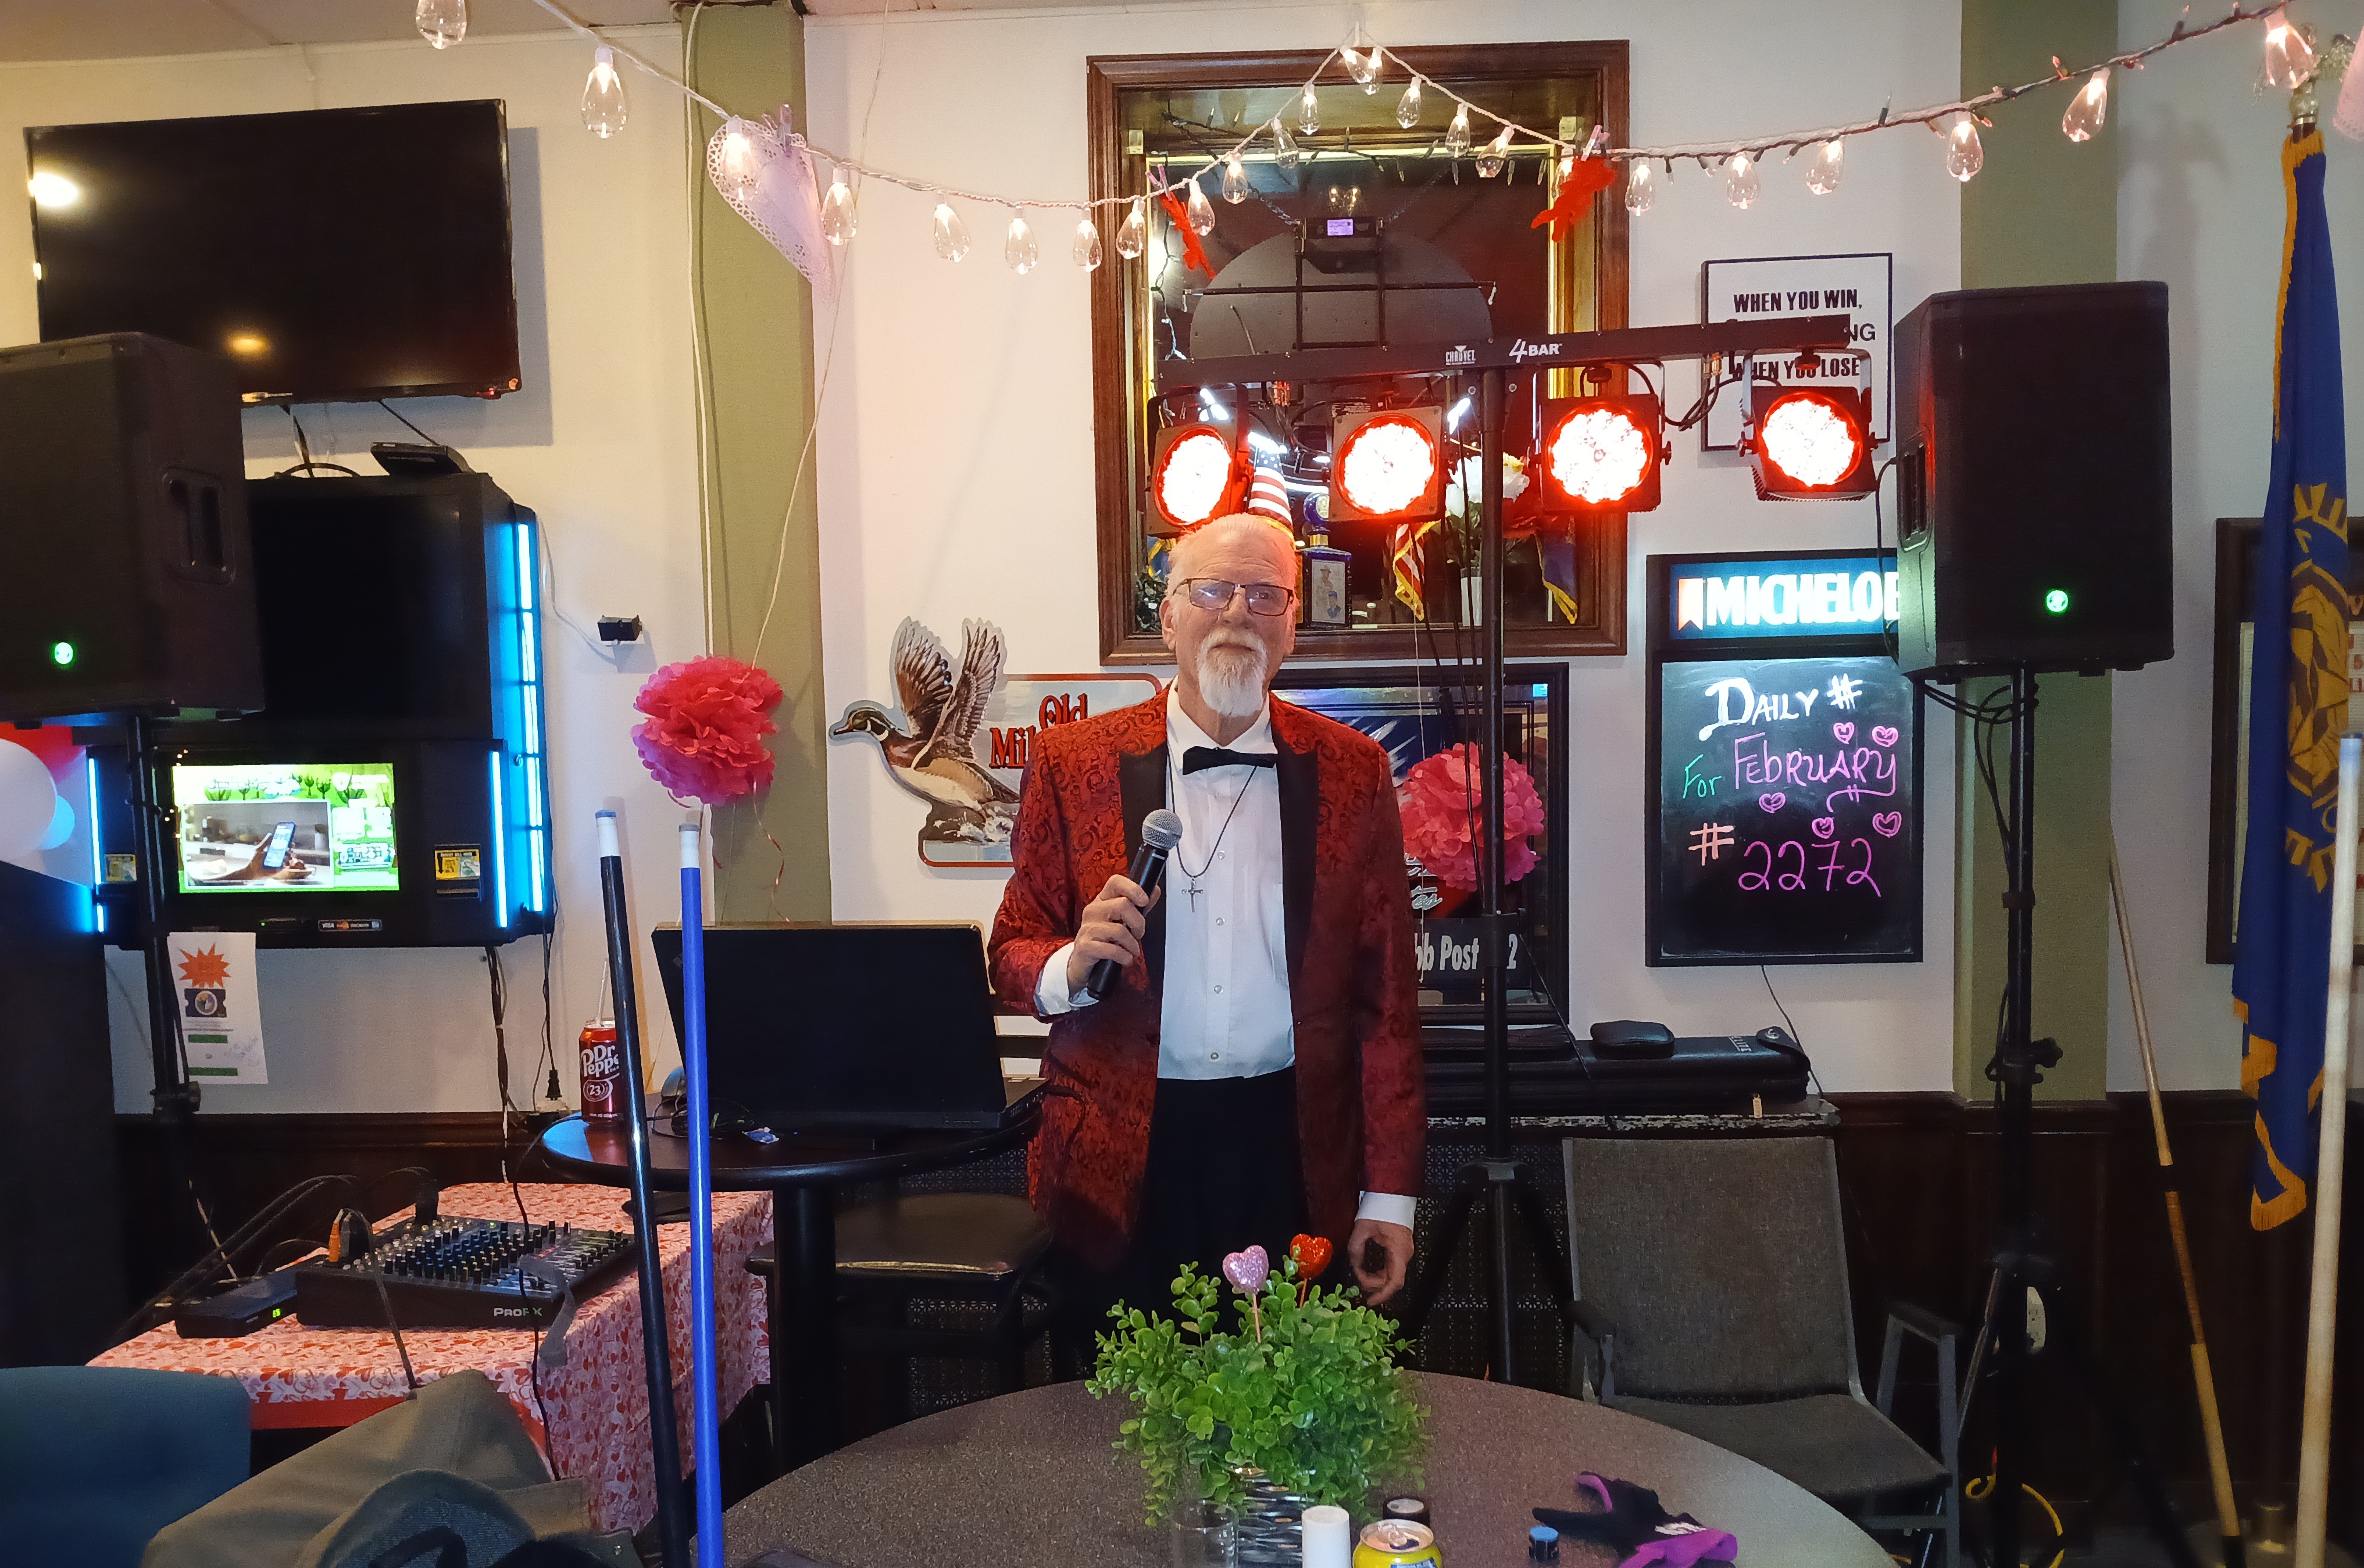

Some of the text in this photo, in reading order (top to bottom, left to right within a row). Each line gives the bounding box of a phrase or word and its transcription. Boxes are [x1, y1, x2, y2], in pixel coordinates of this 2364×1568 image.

[1734, 289, 1862, 313] WHEN YOU WIN,
[1445, 349, 1476, 362] CHAUVET
[1821, 357, 1861, 378] LOSE
[1826, 673, 1863, 710] #
[1039, 692, 1088, 730] Old
[1683, 753, 1722, 799] For
[1688, 822, 1881, 898] # 2272
[1440, 935, 1480, 971] Post
[594, 1045, 616, 1063] Dr
[589, 1084, 601, 1096] 23
